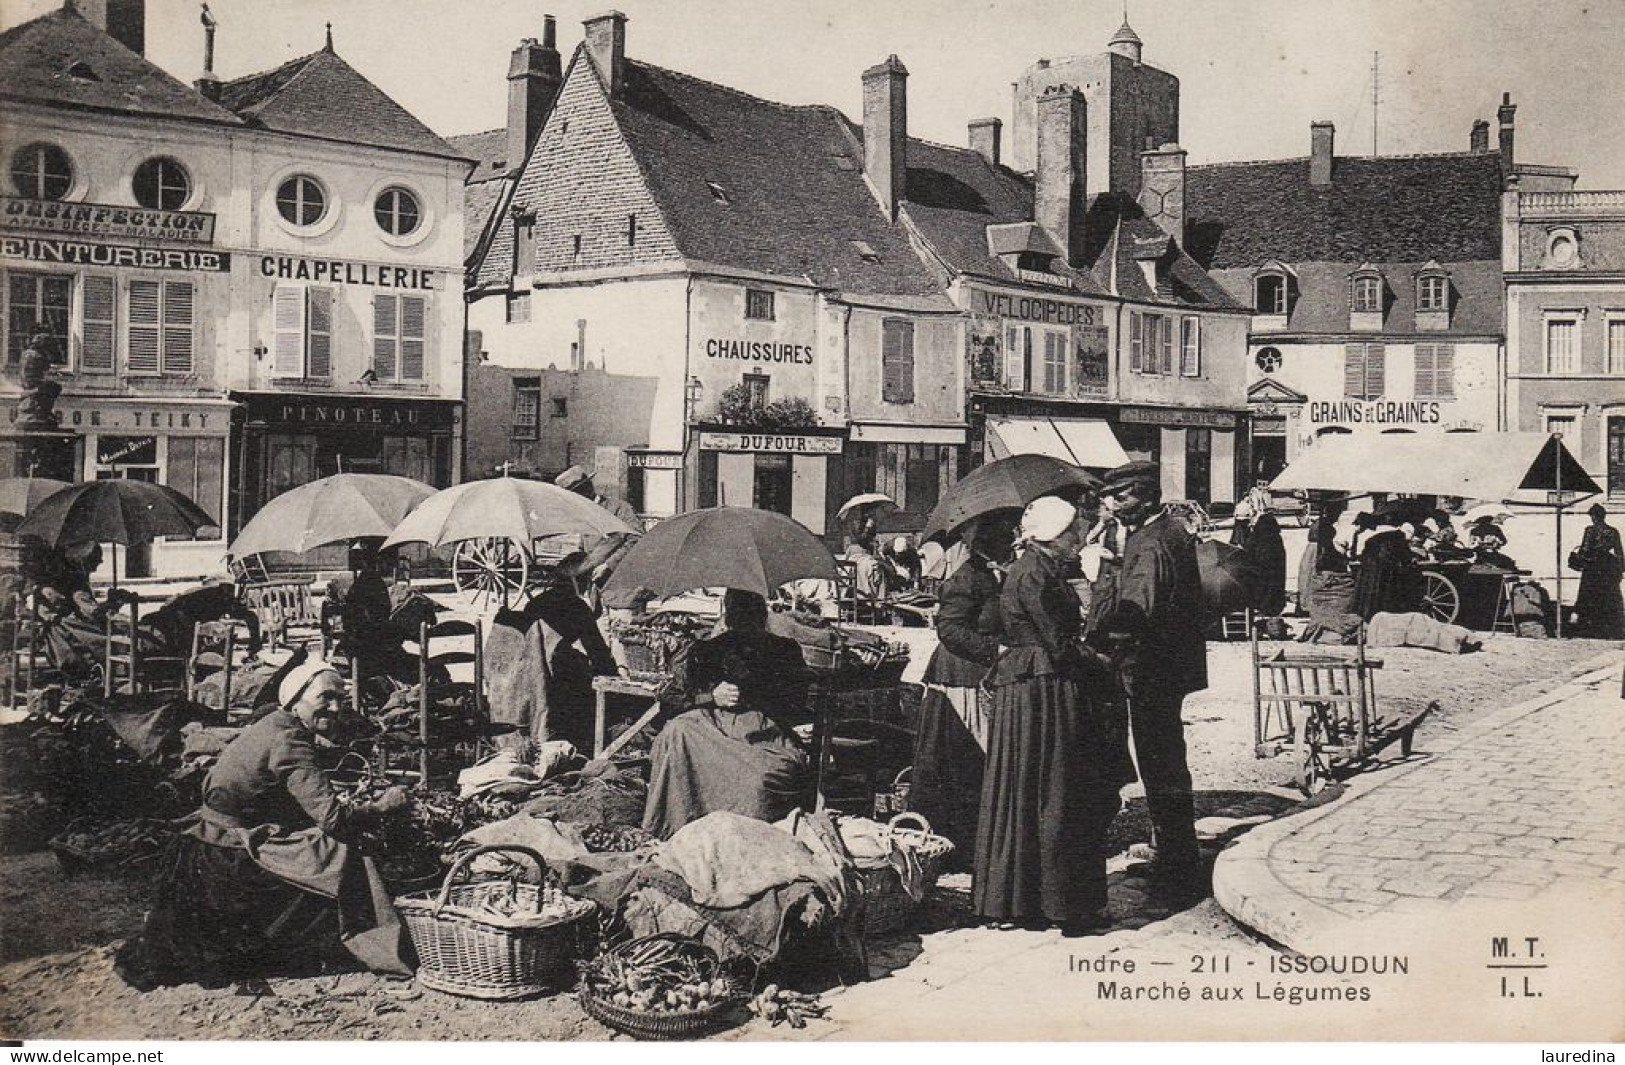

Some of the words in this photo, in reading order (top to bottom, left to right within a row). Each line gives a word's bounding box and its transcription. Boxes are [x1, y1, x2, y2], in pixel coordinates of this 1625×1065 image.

[0, 239, 220, 271] EINTURERIE
[261, 256, 434, 289] CHAPELLERIE
[706, 339, 813, 365] CHAUSSURES
[282, 405, 419, 424] PINOTEAU
[1310, 402, 1363, 423] GRAINS
[1376, 402, 1440, 423] GRAINES
[740, 435, 807, 451] DUFOUR
